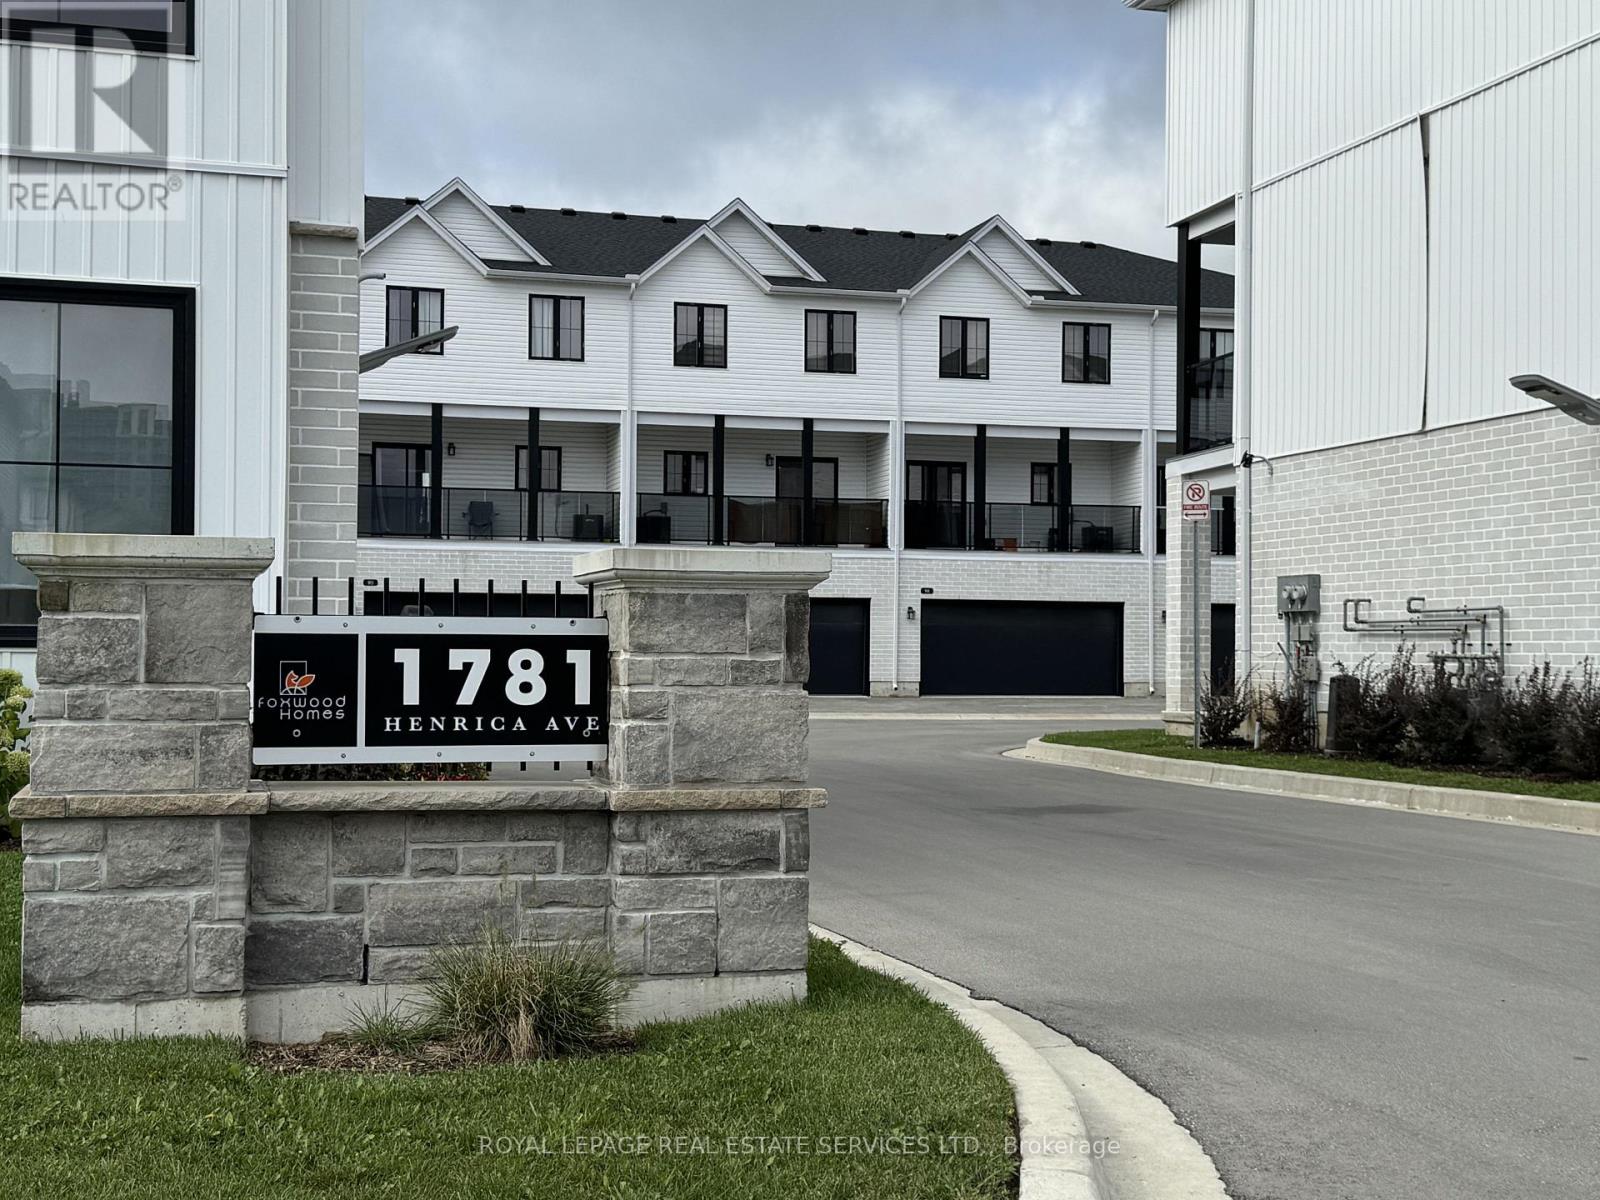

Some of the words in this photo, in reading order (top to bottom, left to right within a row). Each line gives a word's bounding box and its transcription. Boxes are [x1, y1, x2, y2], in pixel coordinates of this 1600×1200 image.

[394, 648, 591, 706] 1781
[279, 708, 345, 720] Homes
[384, 716, 527, 732] HENRICA
[545, 716, 600, 732] AVE
